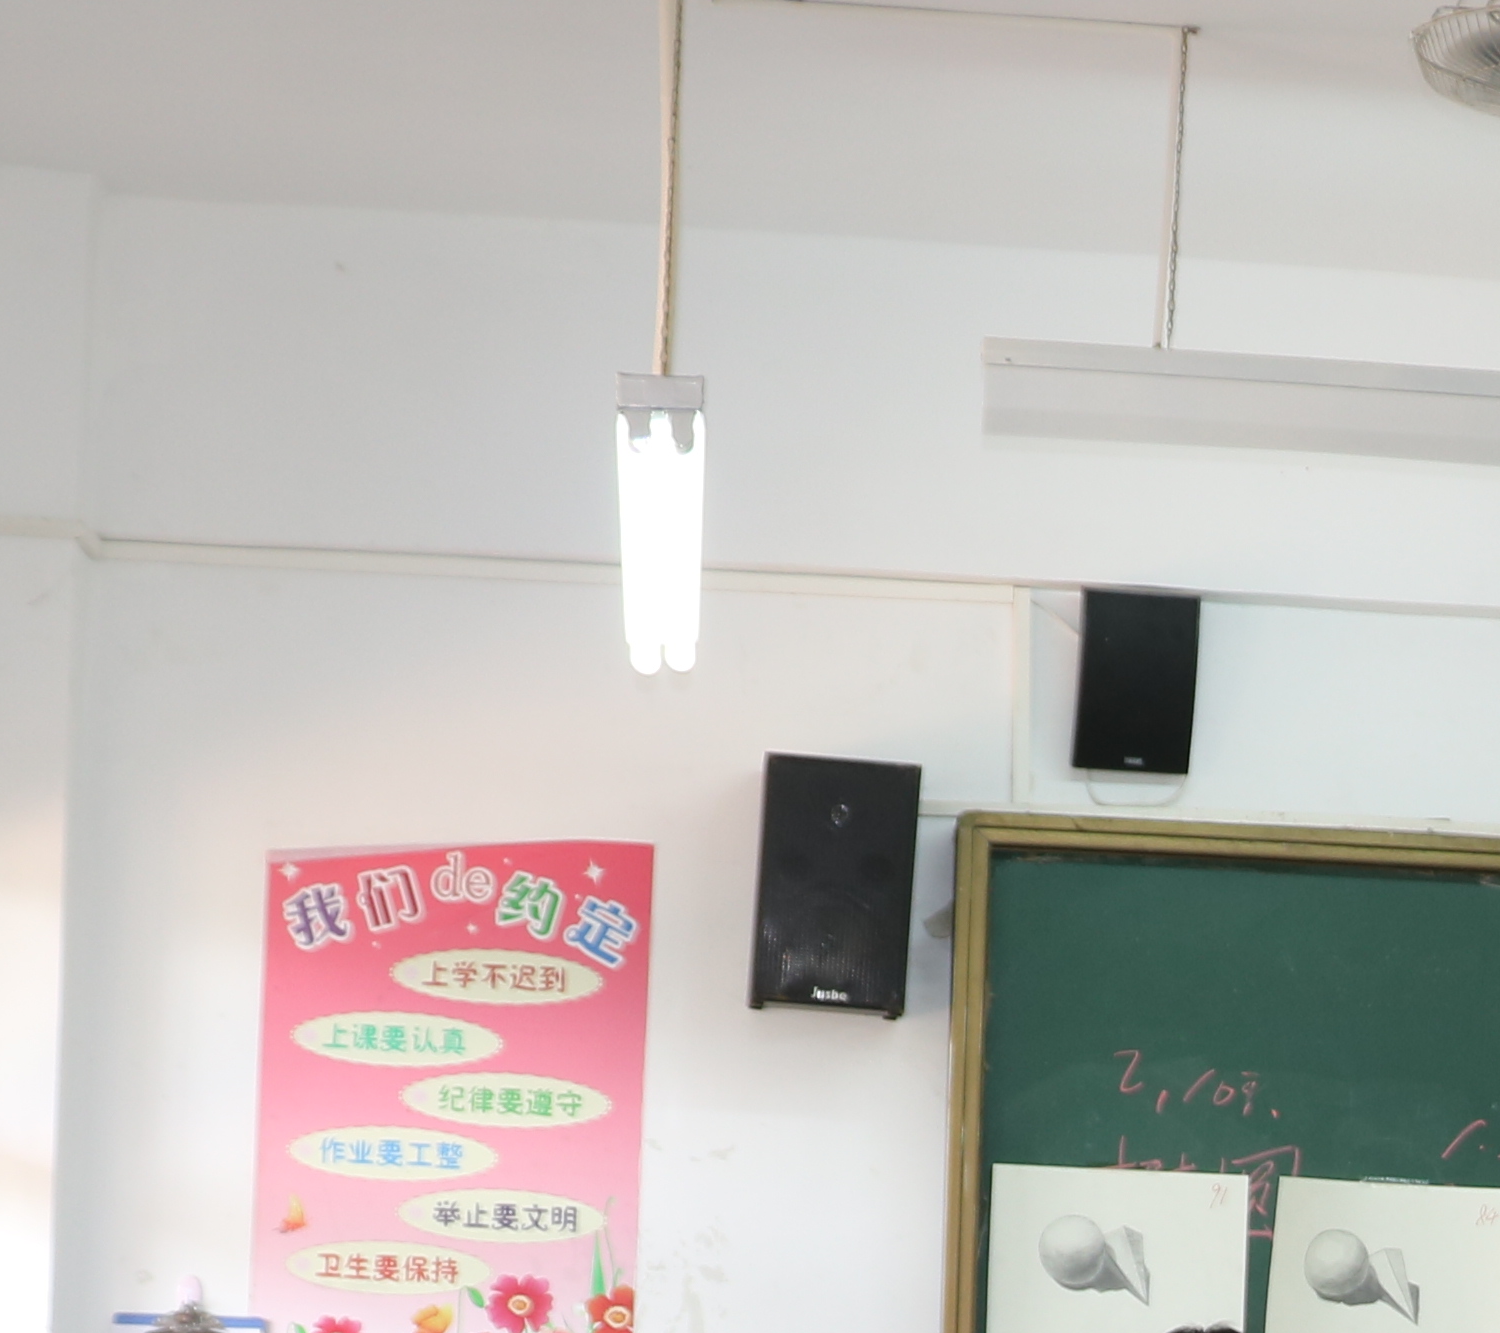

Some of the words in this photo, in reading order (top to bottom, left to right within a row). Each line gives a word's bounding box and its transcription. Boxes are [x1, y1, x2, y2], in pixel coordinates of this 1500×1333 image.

[495, 868, 640, 967] 约定
[423, 960, 567, 994] 上学不迟到
[322, 1023, 467, 1055] 上课要认真
[438, 1085, 584, 1117] 纪律要遵守
[319, 1137, 464, 1170] 作业要工整
[432, 1202, 578, 1233] 举止要文明
[317, 1253, 459, 1284] 卫生要保持
